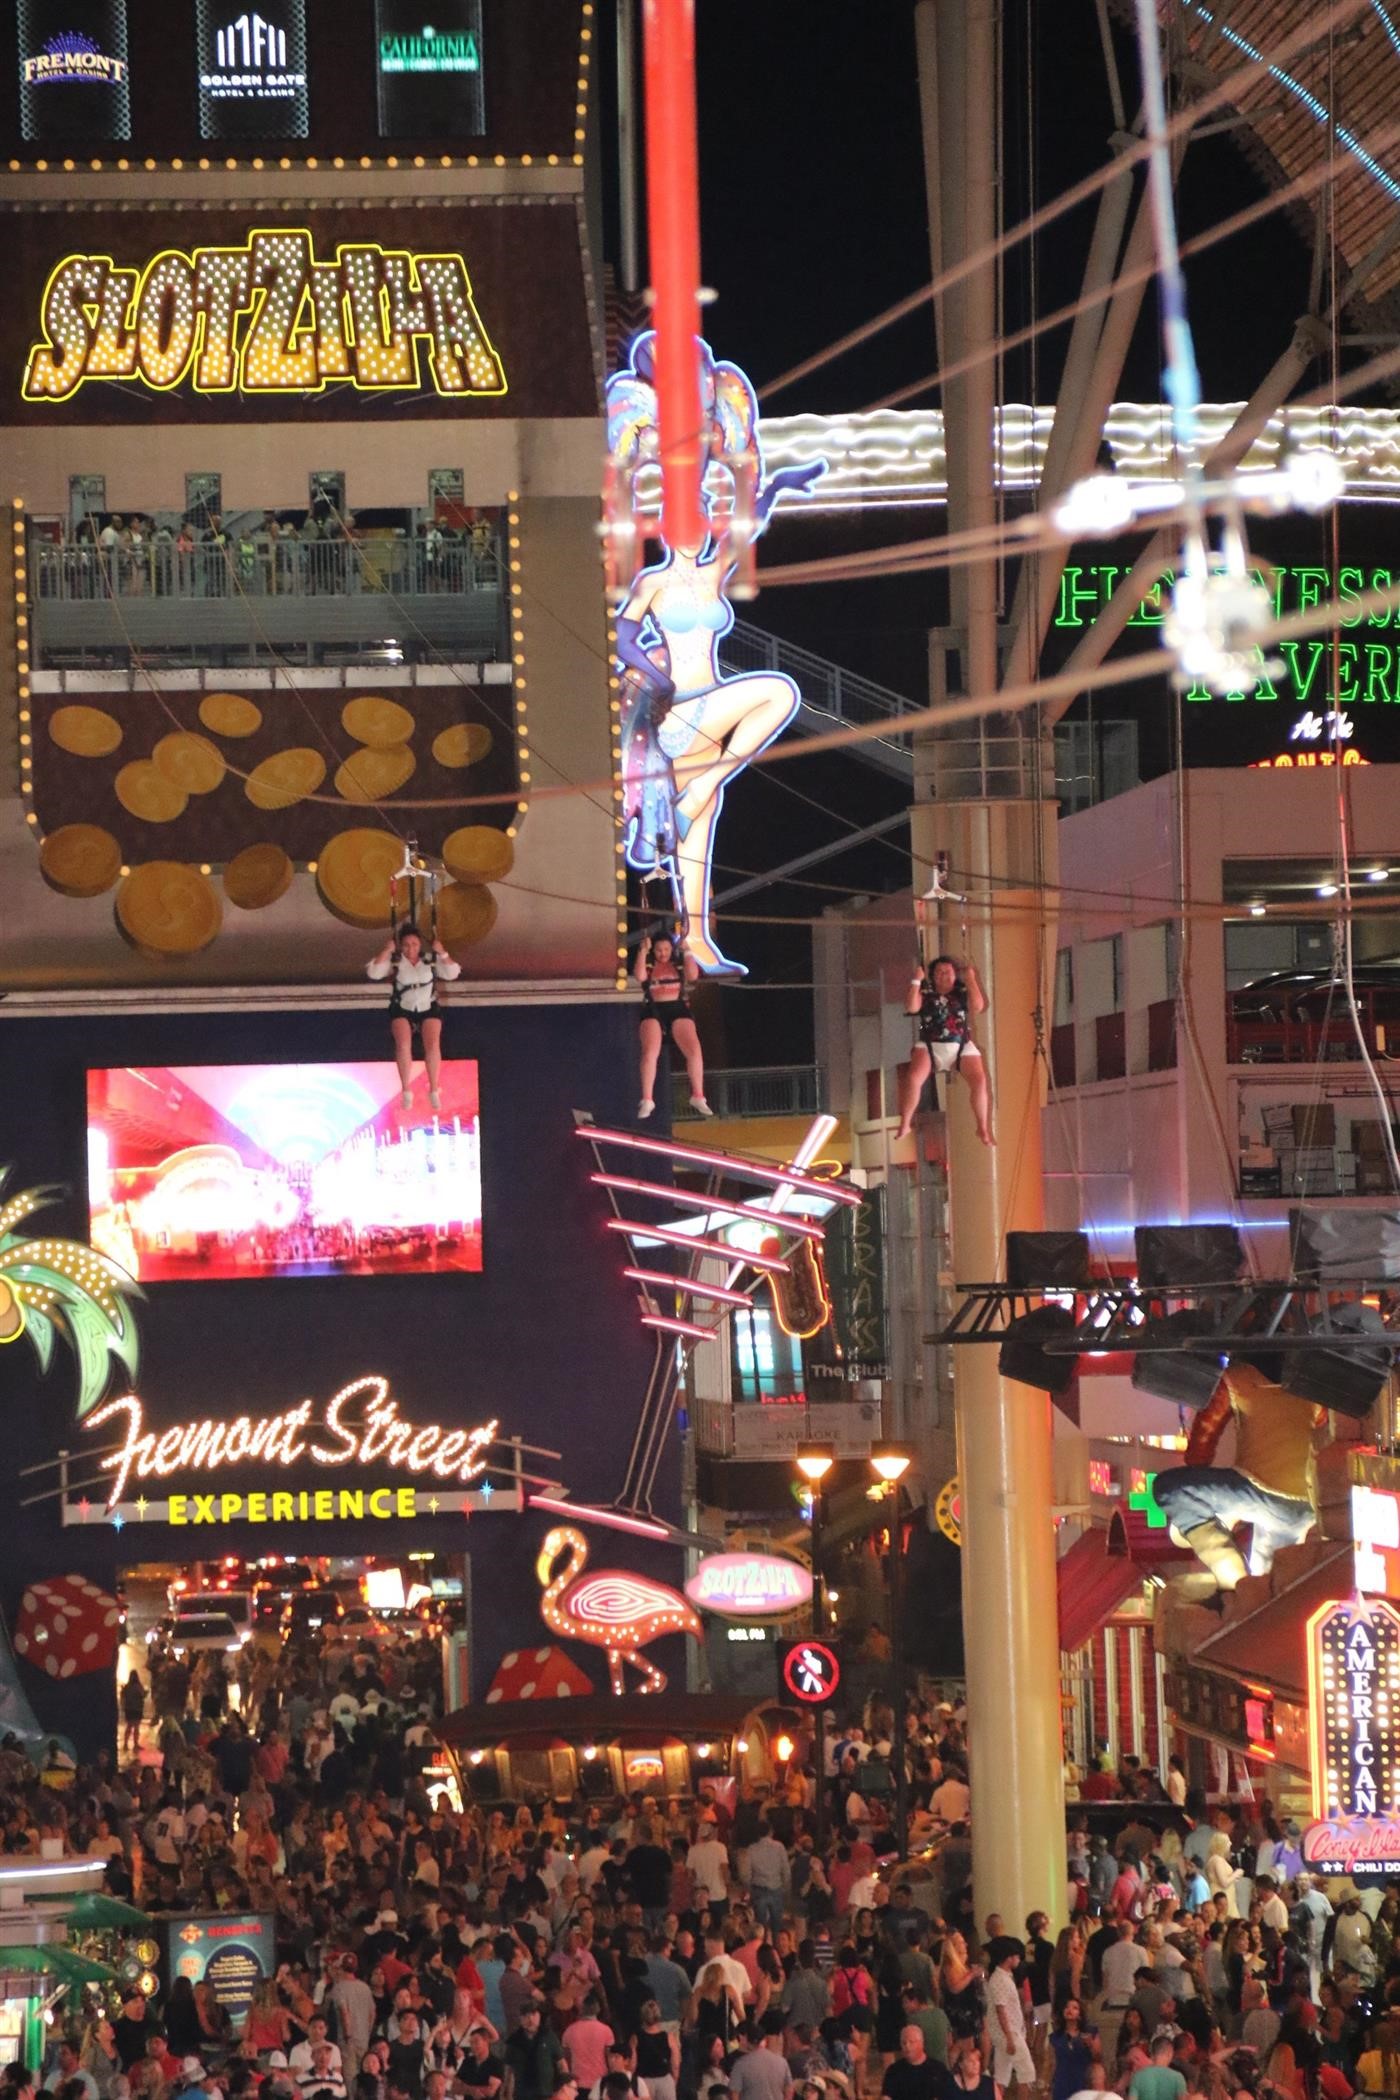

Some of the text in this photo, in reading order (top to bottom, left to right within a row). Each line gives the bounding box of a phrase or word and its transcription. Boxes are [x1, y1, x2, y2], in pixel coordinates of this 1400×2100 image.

[23, 53, 125, 81] FREMONT
[201, 74, 305, 86] GOLDEN GATE
[211, 88, 244, 97] HOTEL
[257, 88, 295, 97] CASINO
[22, 229, 508, 401] SLOTZILLA
[811, 1363, 890, 1381] The Club
[82, 1376, 499, 1516] Fremont Street
[167, 1487, 417, 1525] EXPERIENCE
[1346, 1624, 1378, 1813] AMERICAN
[1311, 1830, 1361, 1873] Coney
[1353, 1862, 1382, 1873] CHILI
